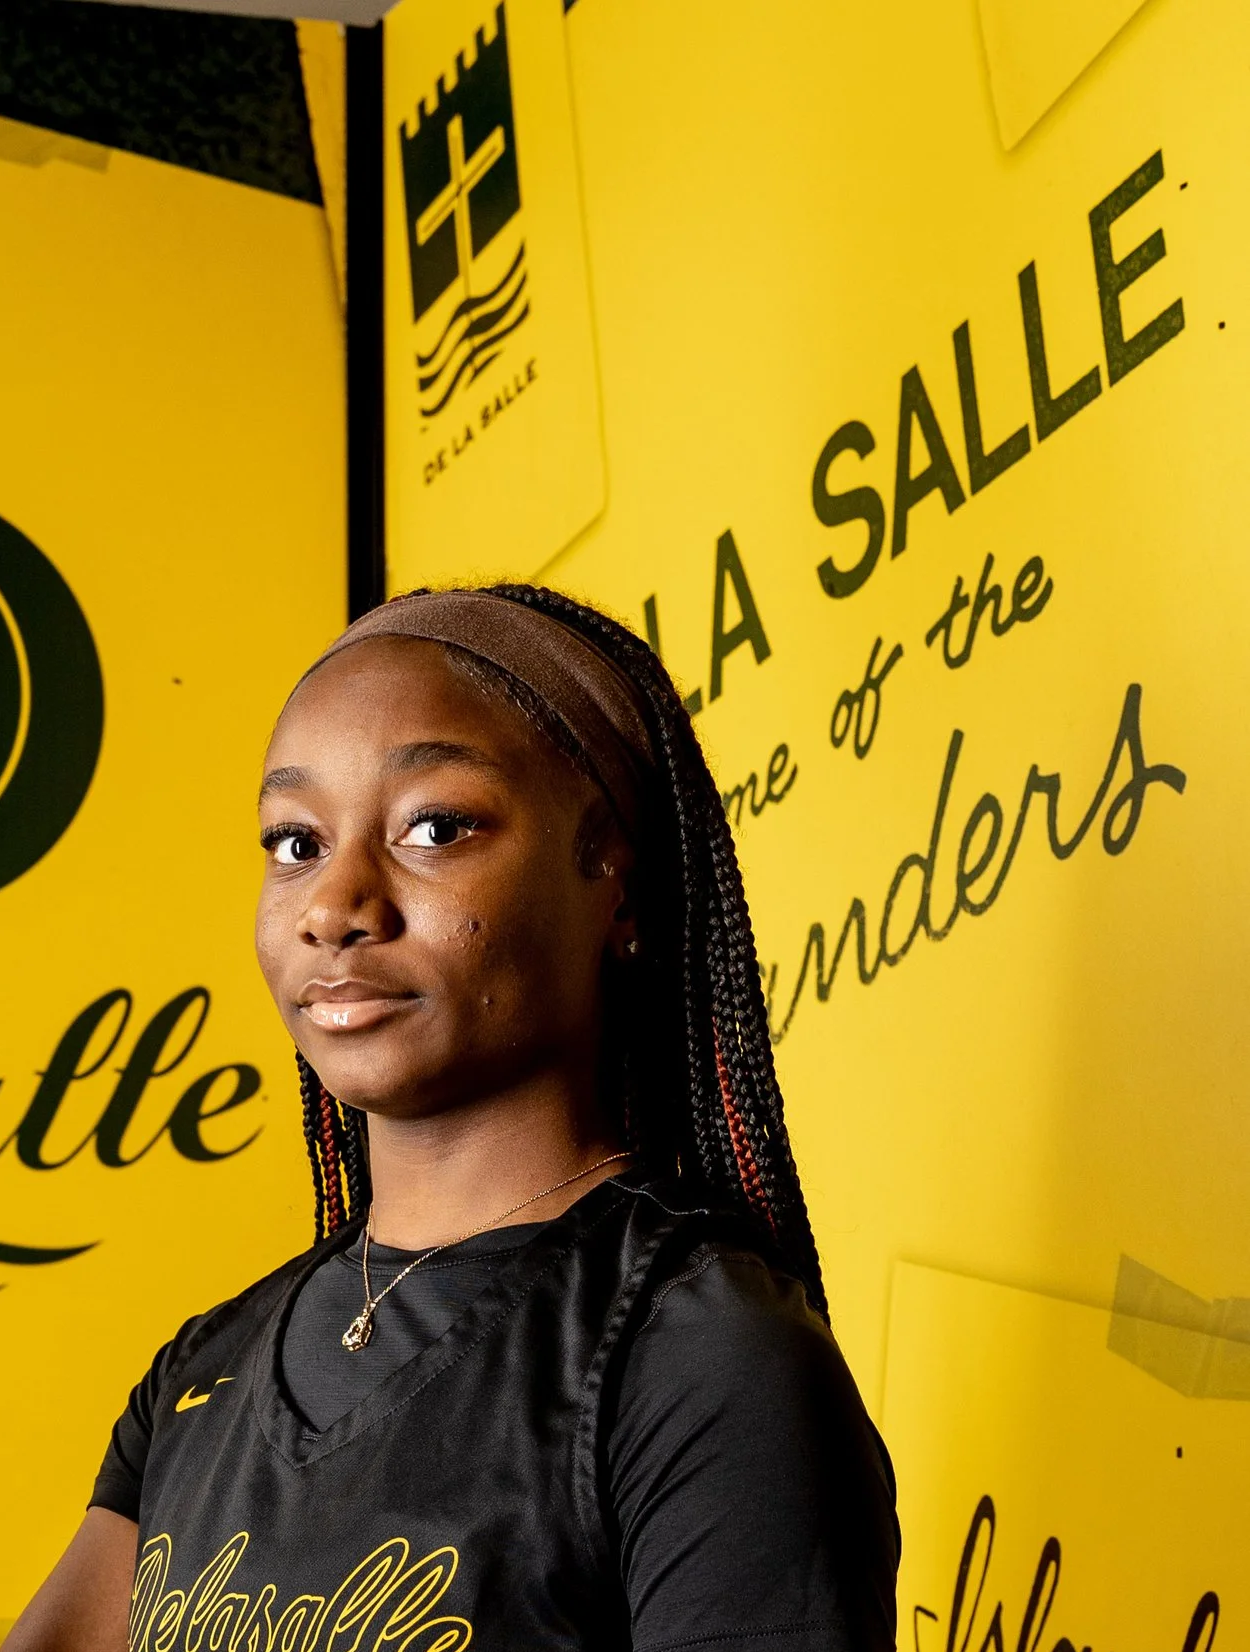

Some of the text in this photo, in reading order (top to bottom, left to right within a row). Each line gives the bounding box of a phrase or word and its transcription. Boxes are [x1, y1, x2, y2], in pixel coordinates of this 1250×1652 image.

[480, 357, 538, 430] SALLE
[809, 148, 1186, 599] SALLE
[830, 636, 904, 760] of
[925, 552, 1054, 670] the
